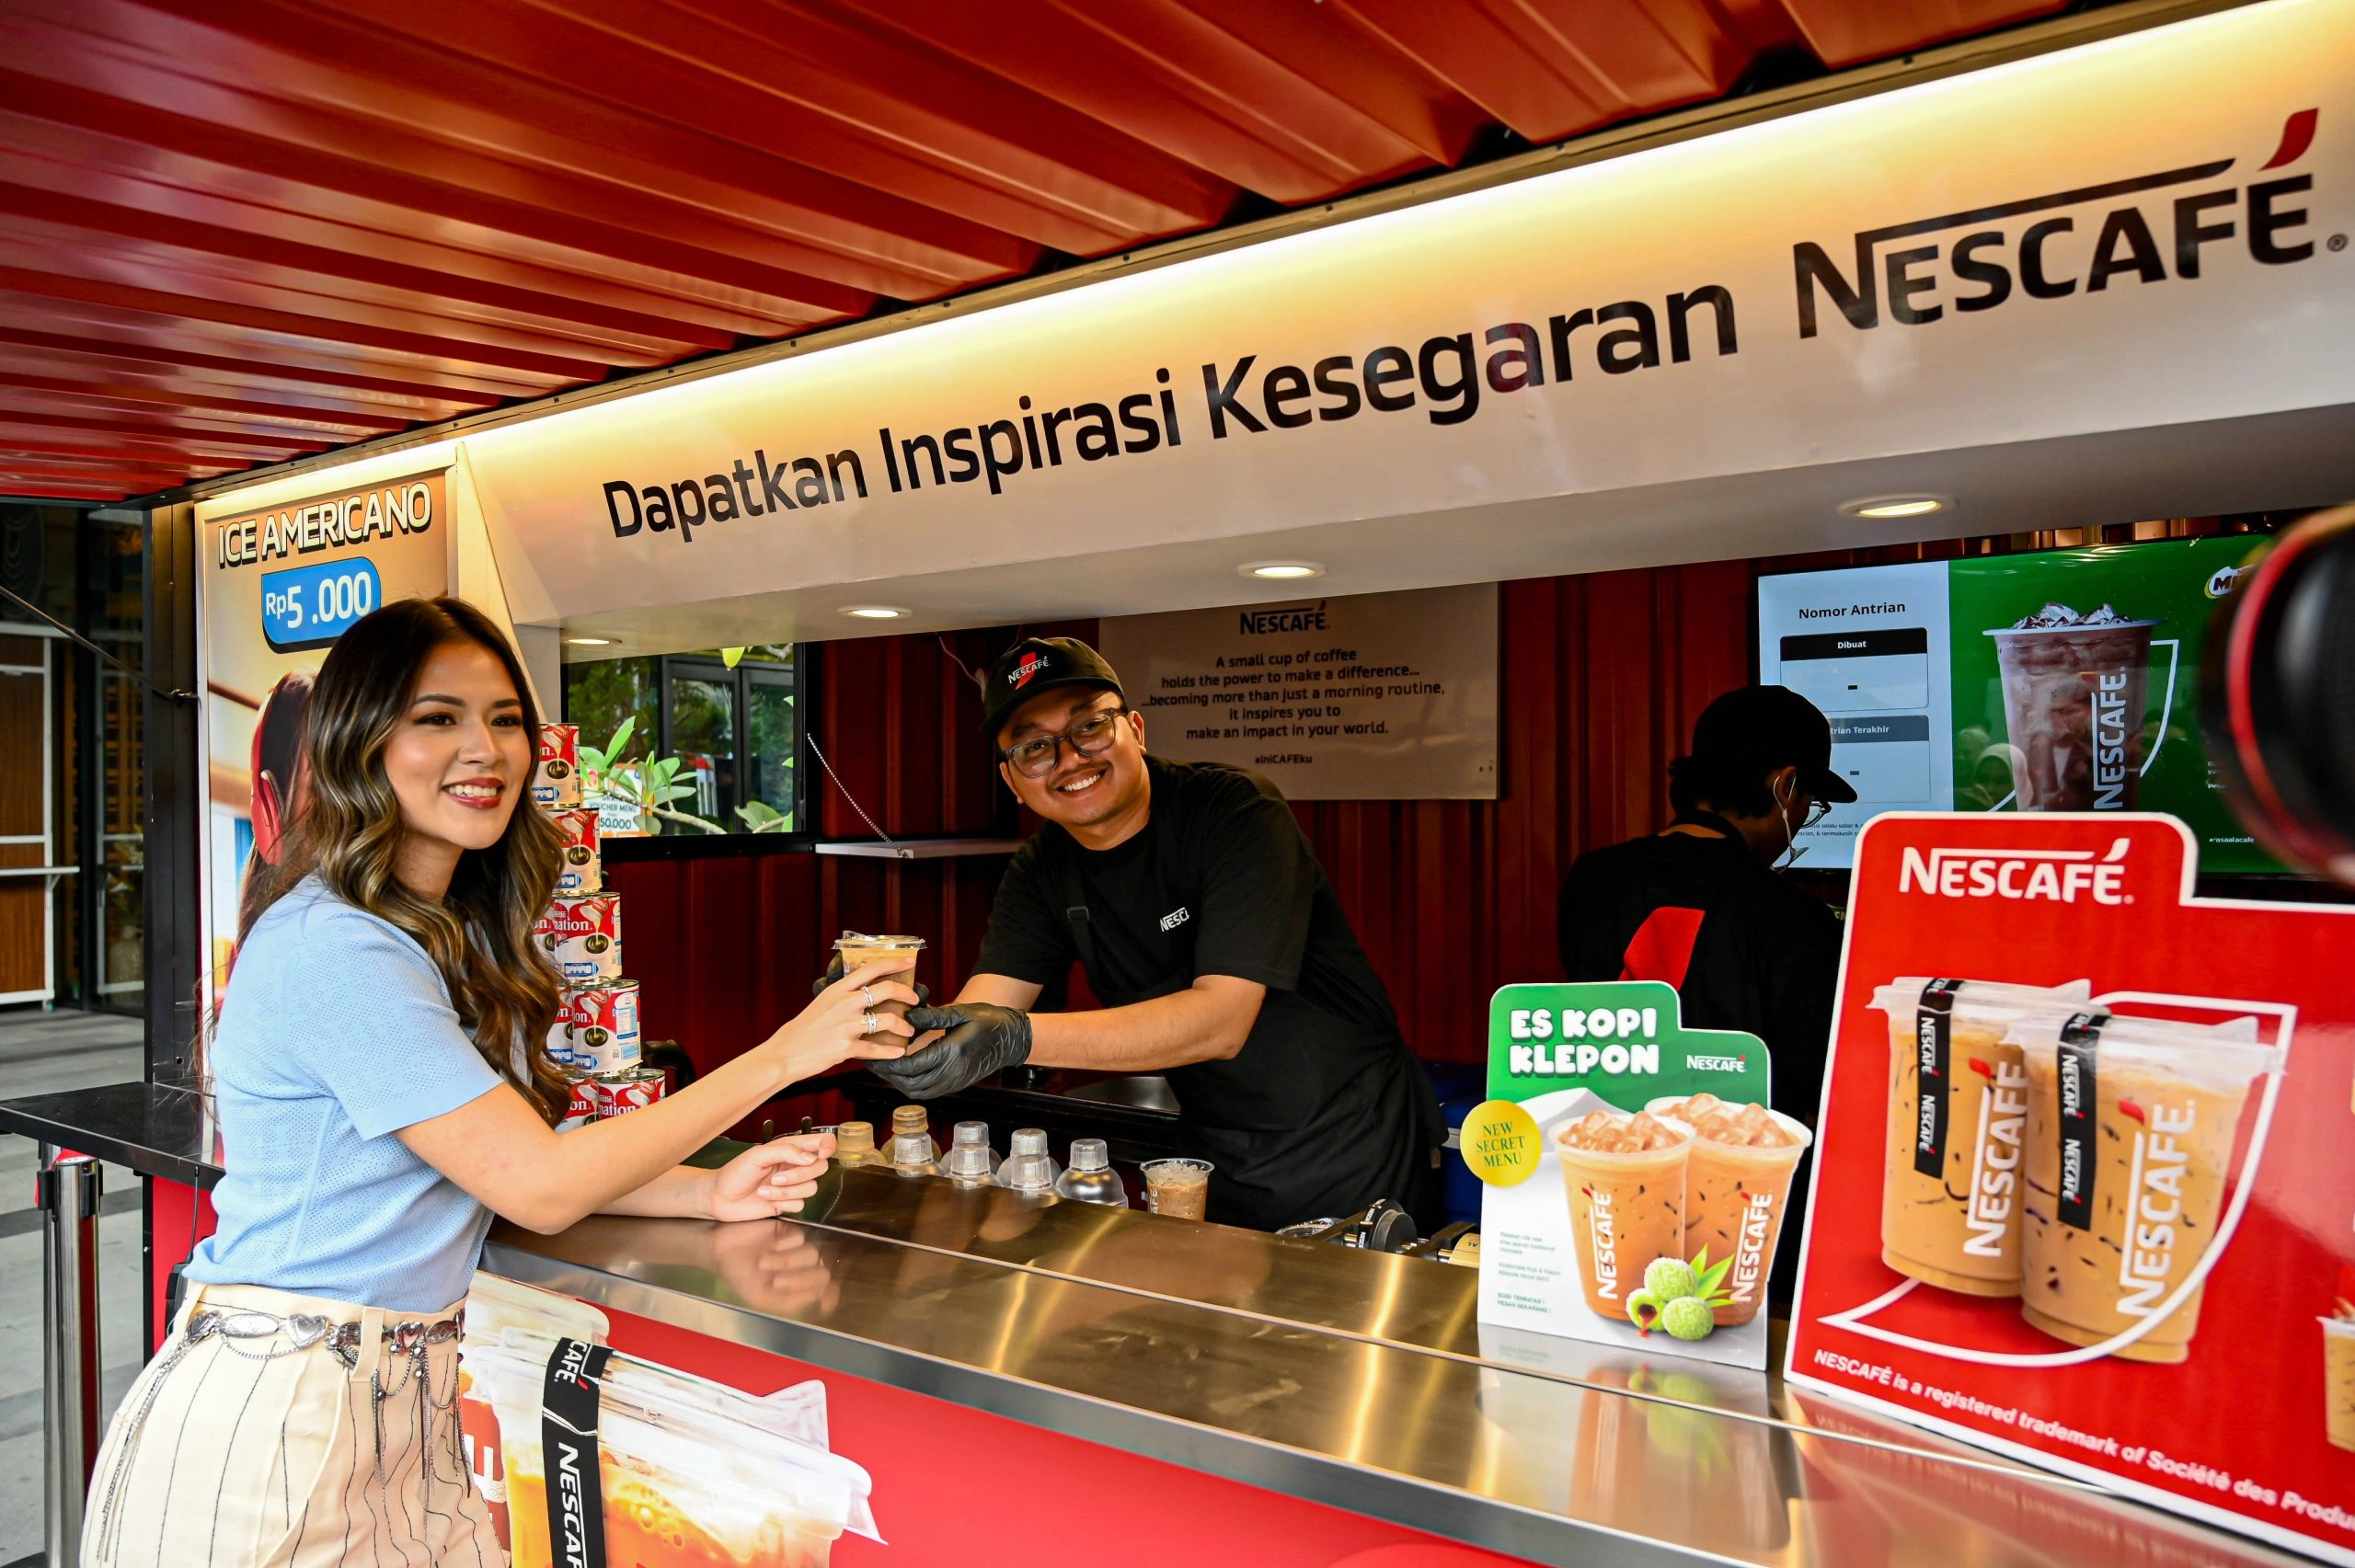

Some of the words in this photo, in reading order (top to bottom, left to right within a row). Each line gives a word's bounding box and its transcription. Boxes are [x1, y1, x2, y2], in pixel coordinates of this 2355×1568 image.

[603, 449, 868, 543] Dapatkan
[879, 367, 1182, 495] Inspirasi
[1201, 284, 1739, 426] Kesegaran
[219, 520, 258, 569] ICE
[262, 482, 432, 561] AMERICANO
[1240, 600, 1327, 635] NESCAFÉ
[1799, 607, 1846, 619] Nomor
[1851, 602, 1906, 615] Antrian
[1838, 641, 1867, 649] Dibuat
[1008, 656, 1051, 684] NESCAFÉ
[1215, 657, 1225, 669] A
[1229, 654, 1265, 668] small
[1269, 656, 1292, 667] cup
[1296, 650, 1310, 663] of
[1314, 648, 1357, 662] coffee
[1162, 676, 1196, 689] holds
[1199, 675, 1220, 687] the
[1223, 674, 1262, 688] power
[1268, 672, 1281, 683] to
[1285, 670, 1322, 682] make
[1326, 670, 1333, 680] a
[1337, 665, 1420, 680] difference...
[1212, 693, 1245, 704] more
[1248, 690, 1280, 702] than
[1281, 688, 1308, 703] just
[1312, 690, 1320, 699] a
[1324, 683, 1384, 699] morning
[1387, 681, 1445, 696] routine,
[1229, 708, 1238, 720] it
[1243, 707, 1293, 721] inspires
[1298, 708, 1322, 721] you
[1327, 705, 1340, 717] to
[1187, 727, 1220, 739] make
[1223, 728, 1239, 738] an
[1243, 726, 1288, 740] impact
[1292, 725, 1304, 736] in
[1308, 725, 1338, 738] your
[1343, 721, 1389, 734] world.
[1830, 727, 1851, 735] trian
[1854, 726, 1890, 734] Terakhir
[1899, 838, 2131, 905] NESCAFÉ
[554, 919, 590, 931] nation
[1160, 907, 1190, 933] NESC
[1509, 1008, 1554, 1041] ES
[1562, 1008, 1658, 1041] KOPI
[1509, 1044, 1660, 1077] KLEPON
[1686, 1054, 1747, 1073] NESCAFÉ
[1483, 1121, 1513, 1137] NEW
[1476, 1136, 1525, 1153] SECRET
[1484, 1151, 1522, 1168] MENU
[555, 1340, 590, 1391] CAFÉ
[1813, 1349, 1892, 1385] NESCAFÉ
[1892, 1374, 1909, 1391] is
[1910, 1382, 1923, 1395] a
[1924, 1387, 2017, 1425] registered
[2018, 1412, 2119, 1457] trademark
[2120, 1446, 2147, 1465] of
[2146, 1449, 2232, 1492] Société
[2233, 1479, 2279, 1505] des
[558, 1442, 589, 1568] NESCAF
